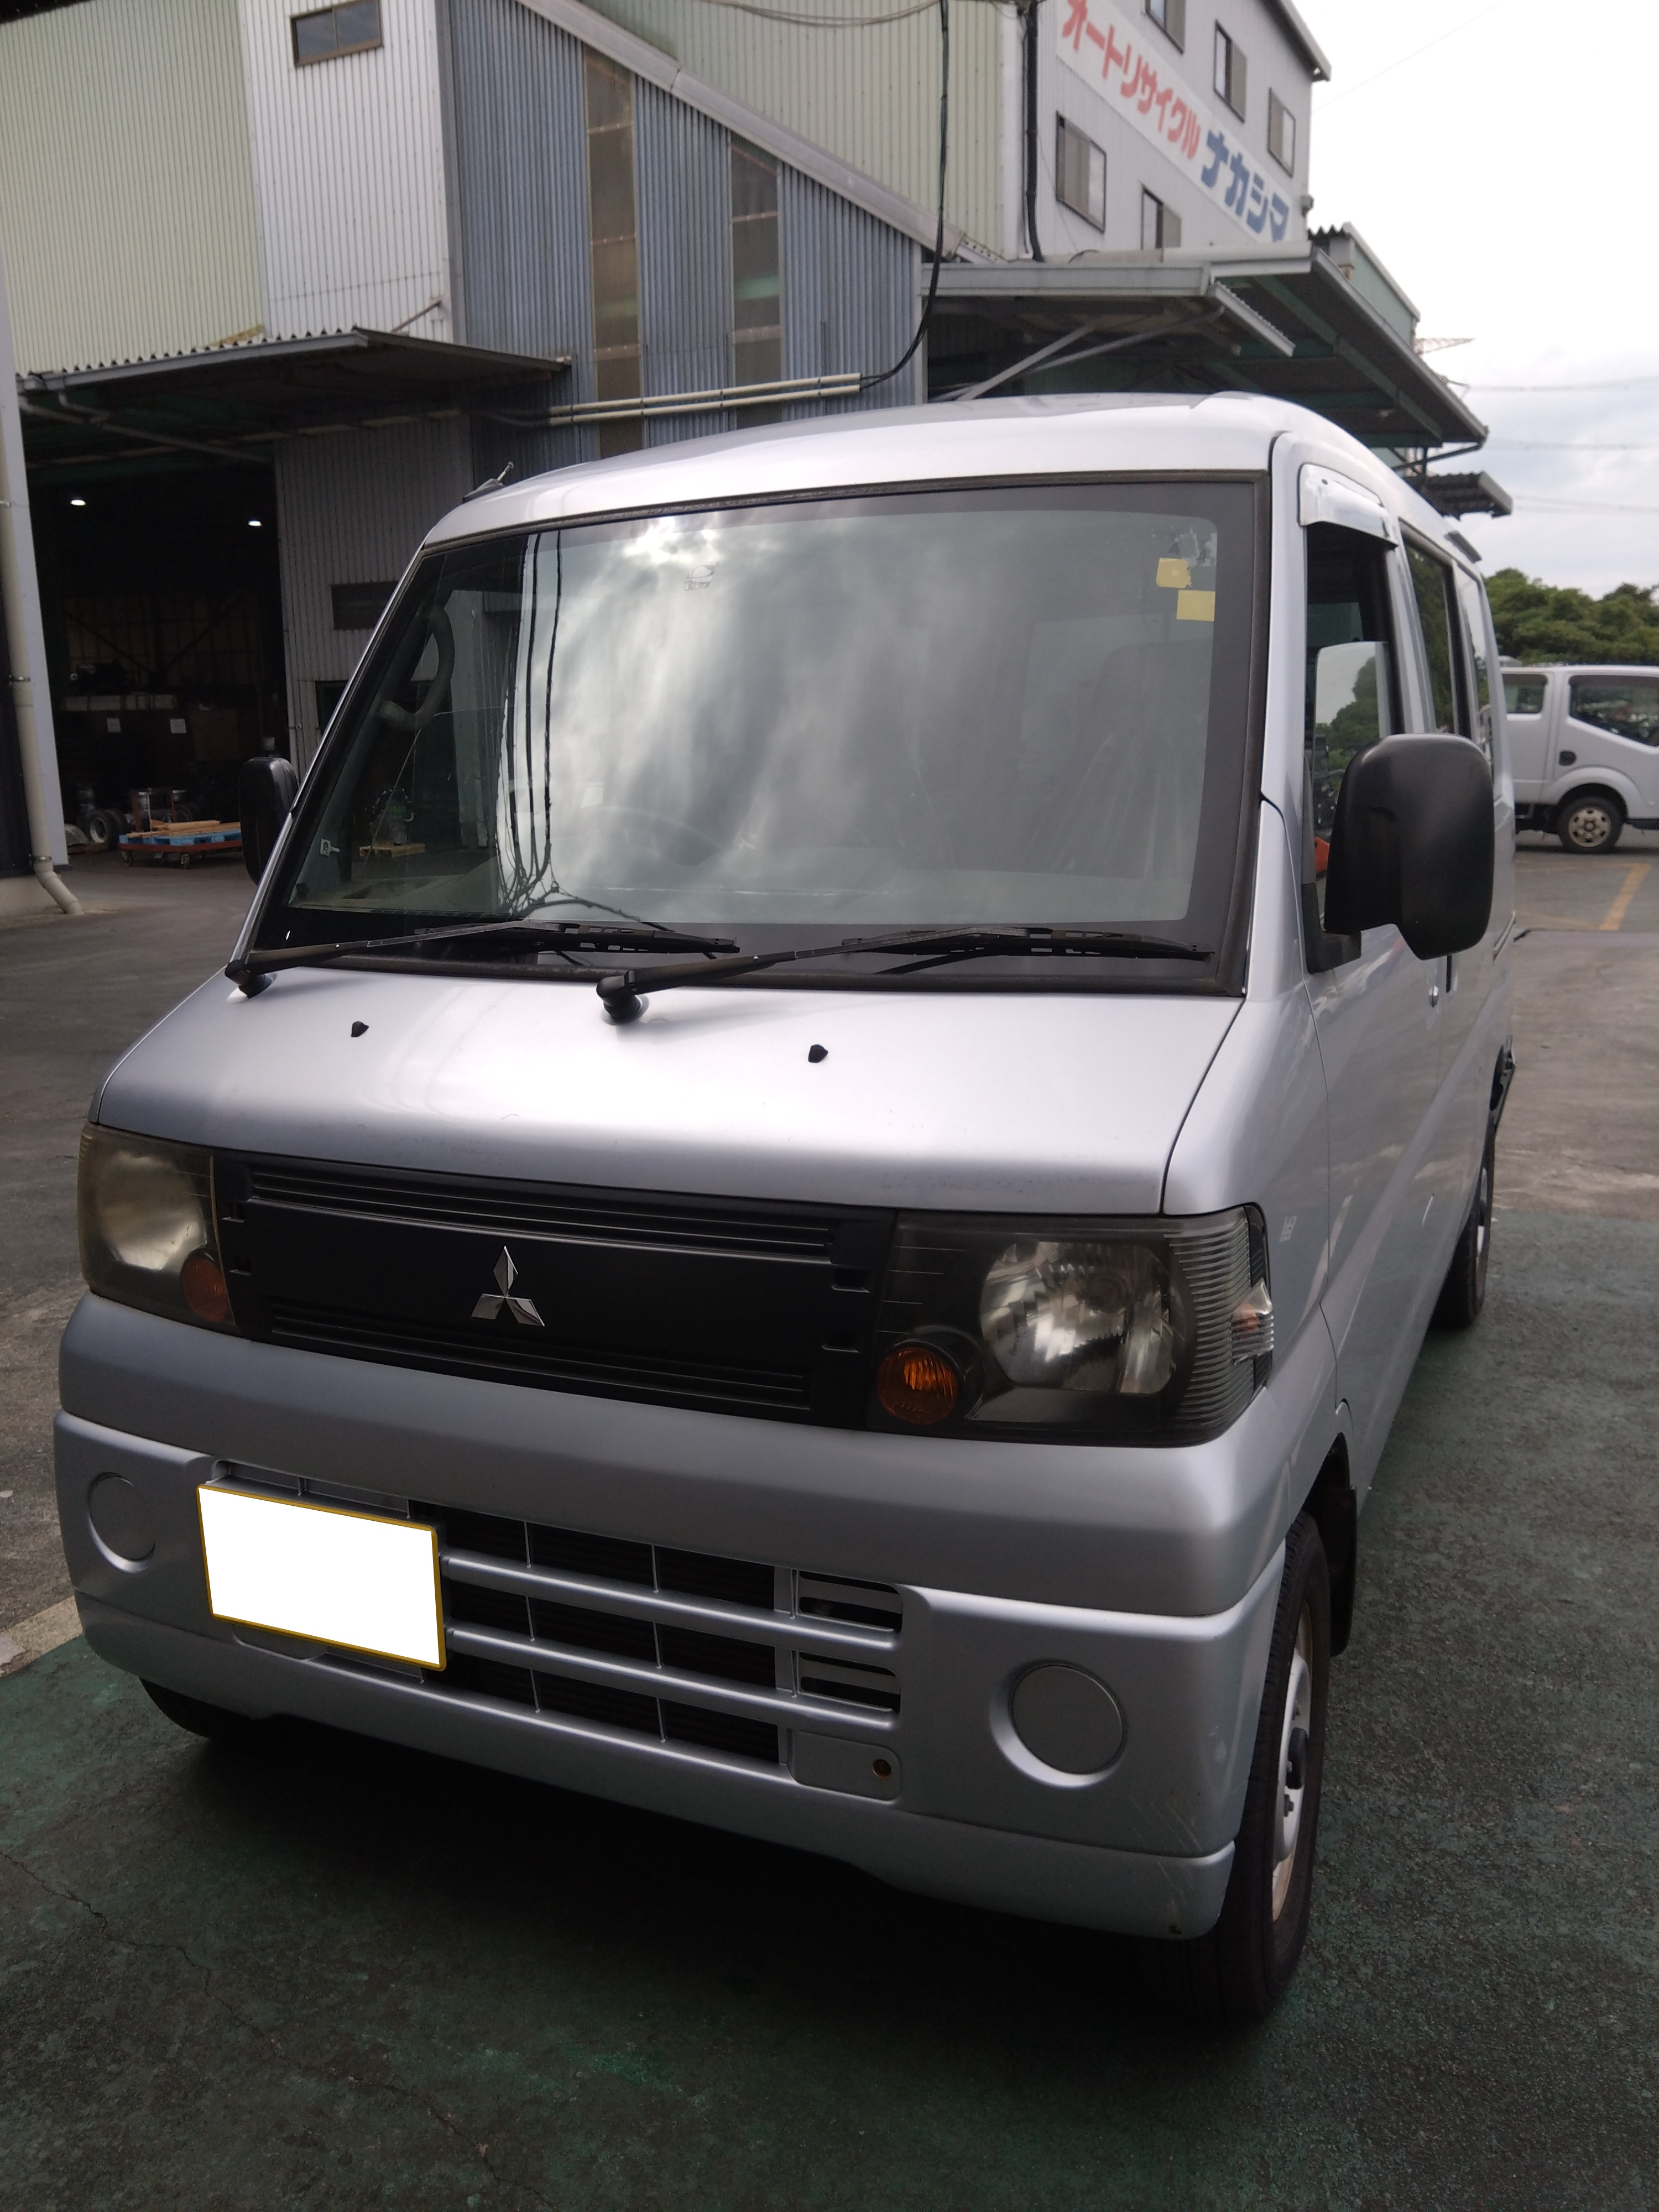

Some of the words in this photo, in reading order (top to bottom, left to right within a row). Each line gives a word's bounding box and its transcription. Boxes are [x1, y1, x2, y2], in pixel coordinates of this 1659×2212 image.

[1062, 0, 1201, 160] オートリサイクル
[1201, 129, 1290, 242] ナカシマ
